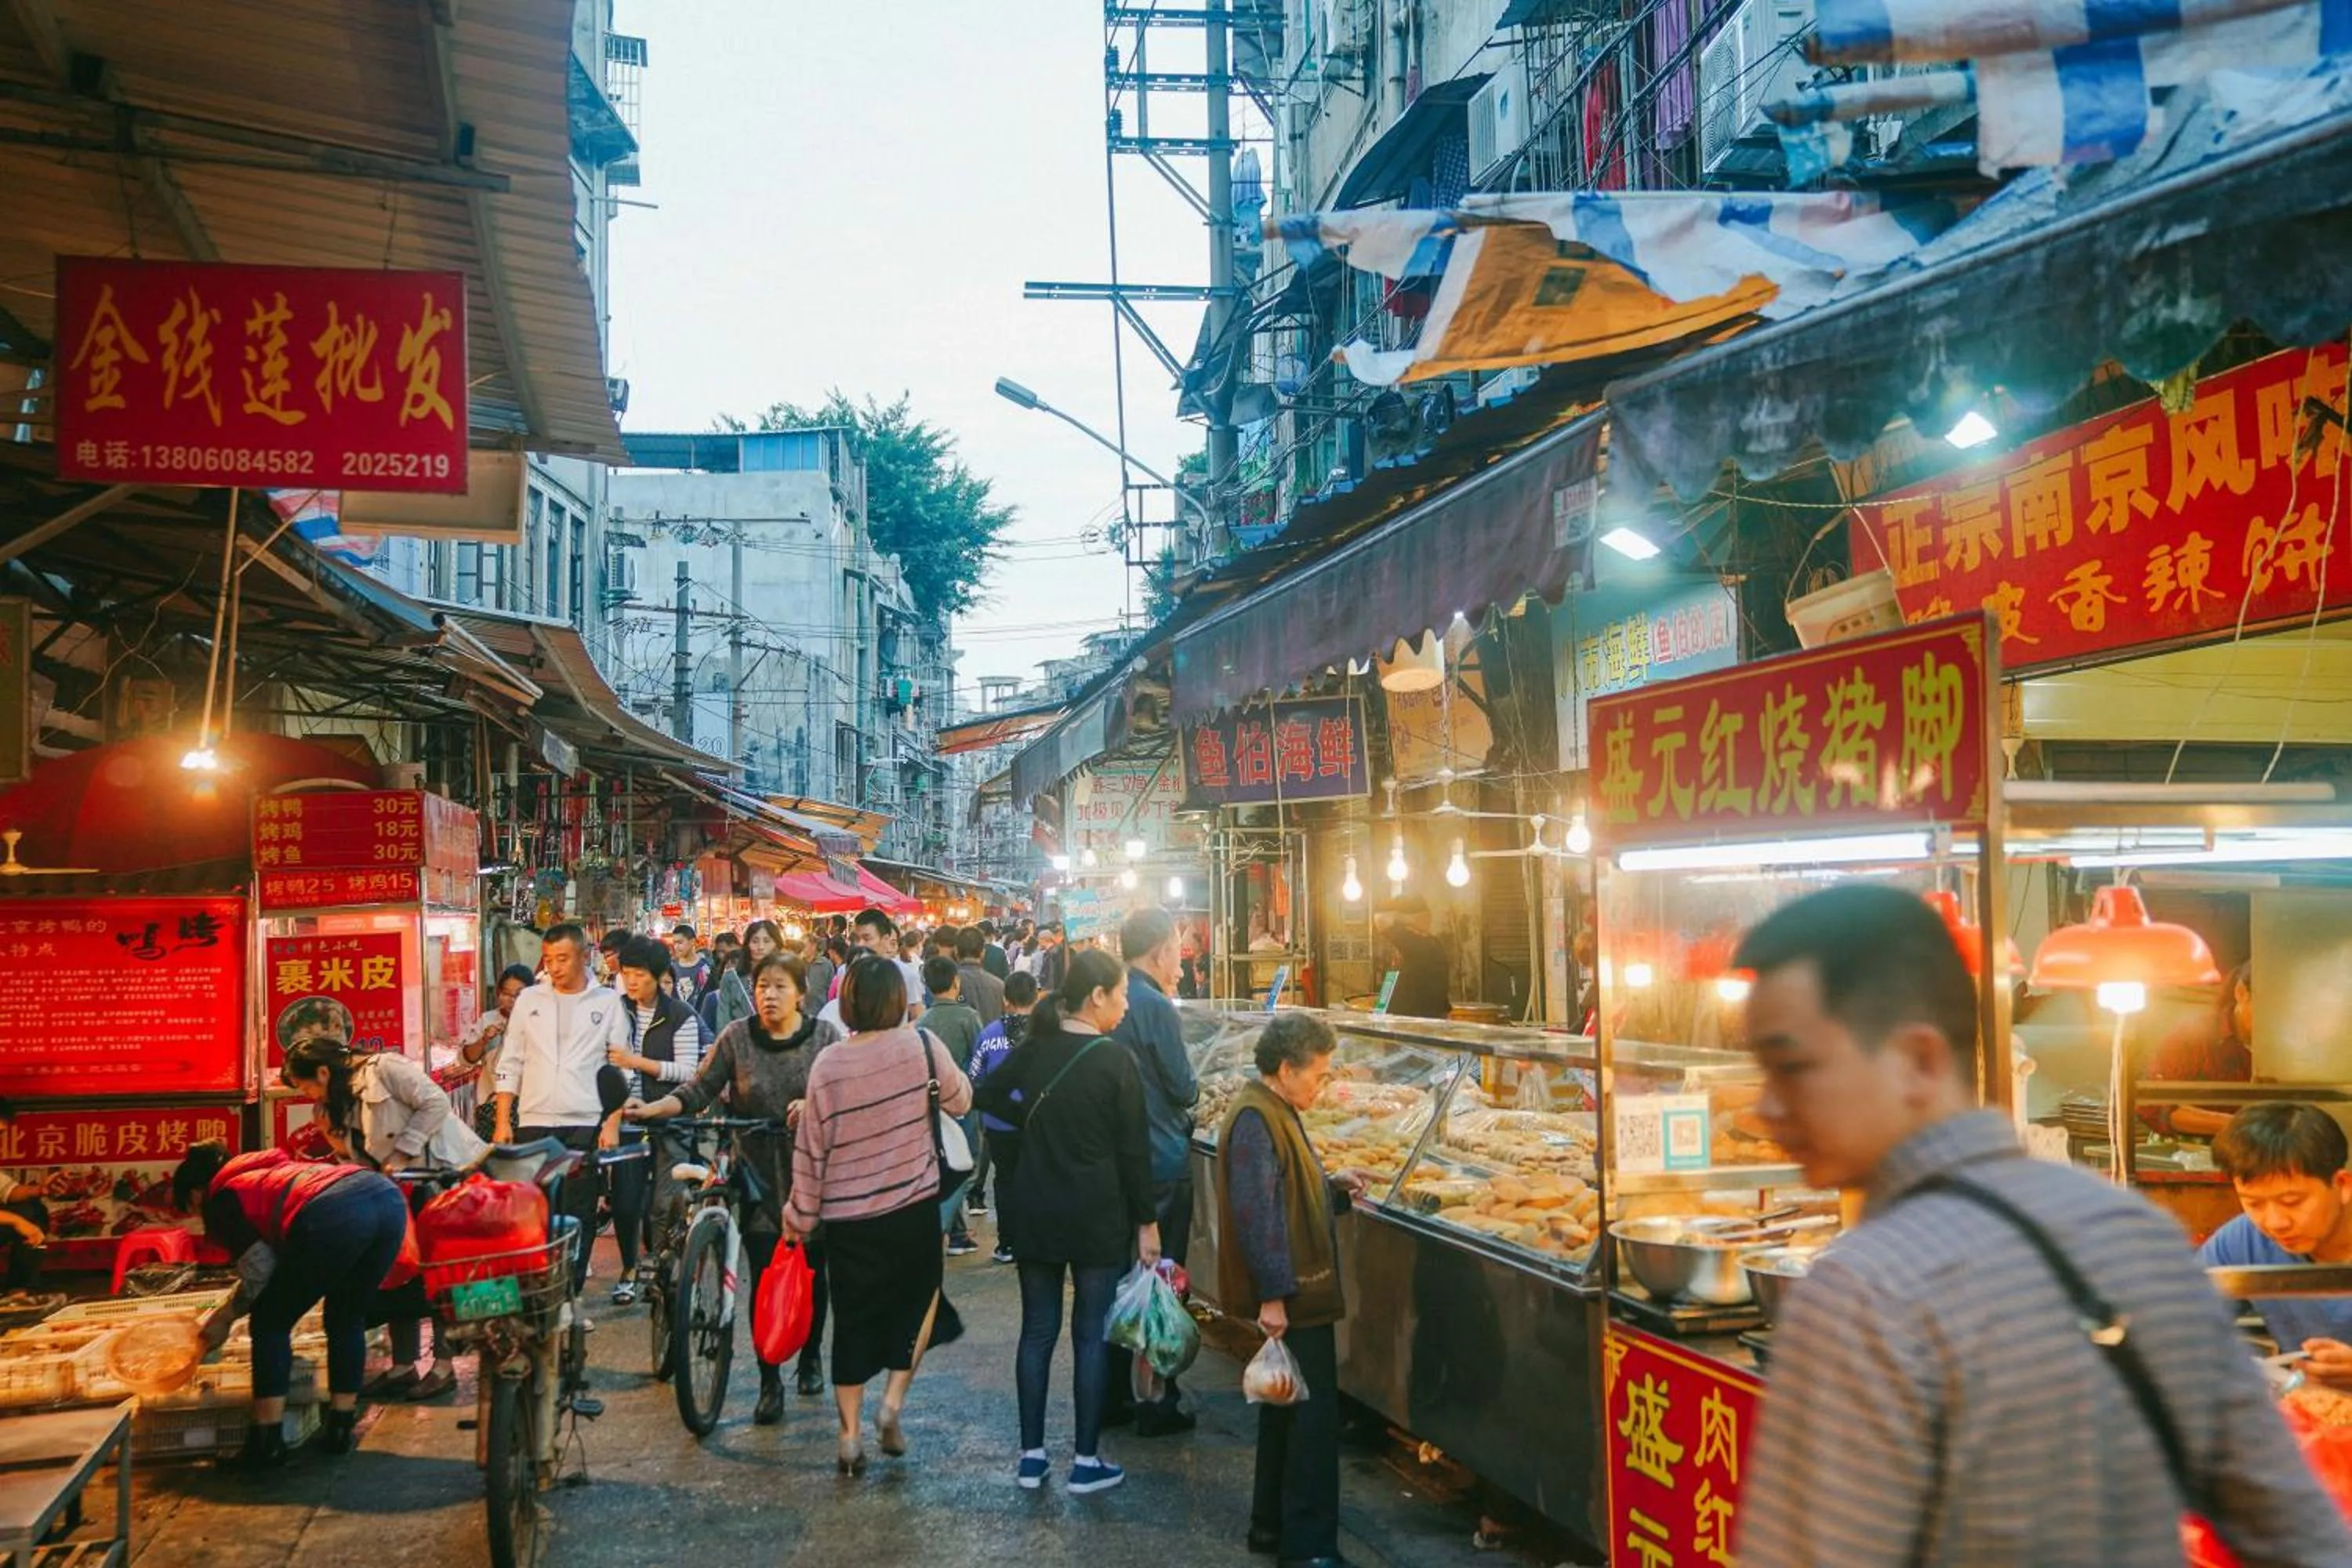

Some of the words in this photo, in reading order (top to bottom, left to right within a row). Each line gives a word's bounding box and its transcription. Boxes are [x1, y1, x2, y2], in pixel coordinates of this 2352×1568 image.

[69, 283, 454, 431] 金线莲批发
[342, 452, 449, 478] 2025219
[1195, 716, 1357, 787] 鱼伯海鲜
[1600, 652, 1963, 825] 盛元红烧猪脚
[259, 798, 303, 818] 烤鸭
[372, 797, 419, 815] 30元
[259, 822, 303, 842] 烤鸡
[374, 821, 419, 838] 18元
[259, 844, 303, 864] 烤鱼
[373, 844, 419, 862] 30元
